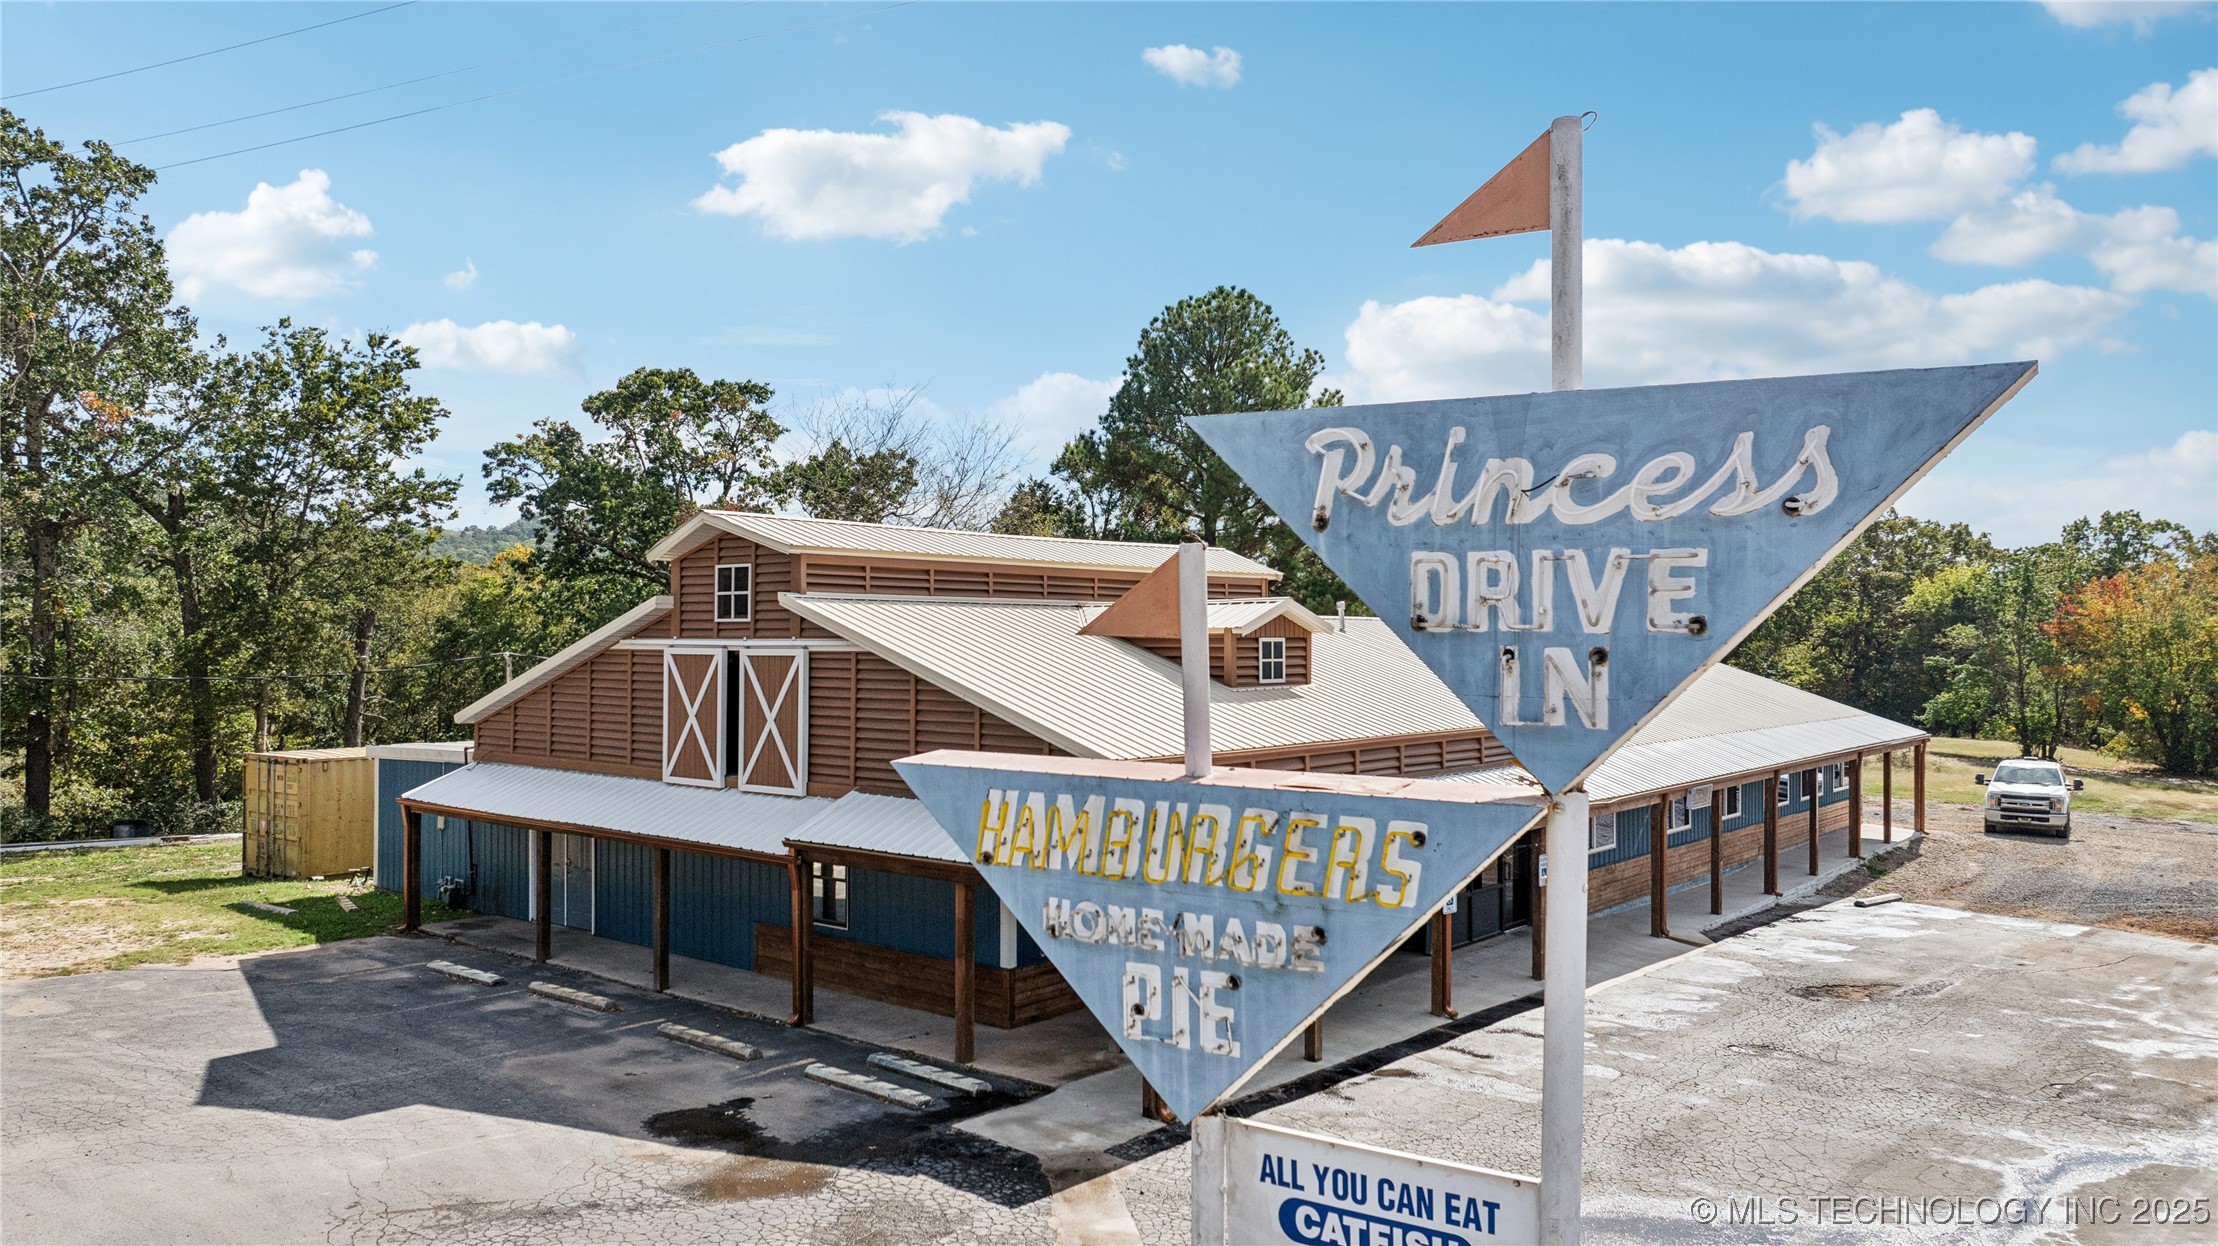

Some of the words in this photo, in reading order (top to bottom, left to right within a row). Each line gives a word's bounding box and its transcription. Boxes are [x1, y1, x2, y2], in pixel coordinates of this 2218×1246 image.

[1305, 424, 1839, 532] Princess
[1410, 548, 1708, 634] DRIVE
[1500, 646, 1610, 730] IN
[976, 789, 1428, 908] HAMBURGERS
[1043, 896, 1165, 952] HOME
[1175, 911, 1327, 973] MADE
[1123, 961, 1241, 1058] PIE
[1260, 1153, 1305, 1192] ALL
[1312, 1163, 1368, 1202] YOU
[1377, 1177, 1435, 1221] CAN
[1445, 1192, 1501, 1235] EAT
[1294, 1204, 1460, 1246] CATFI
